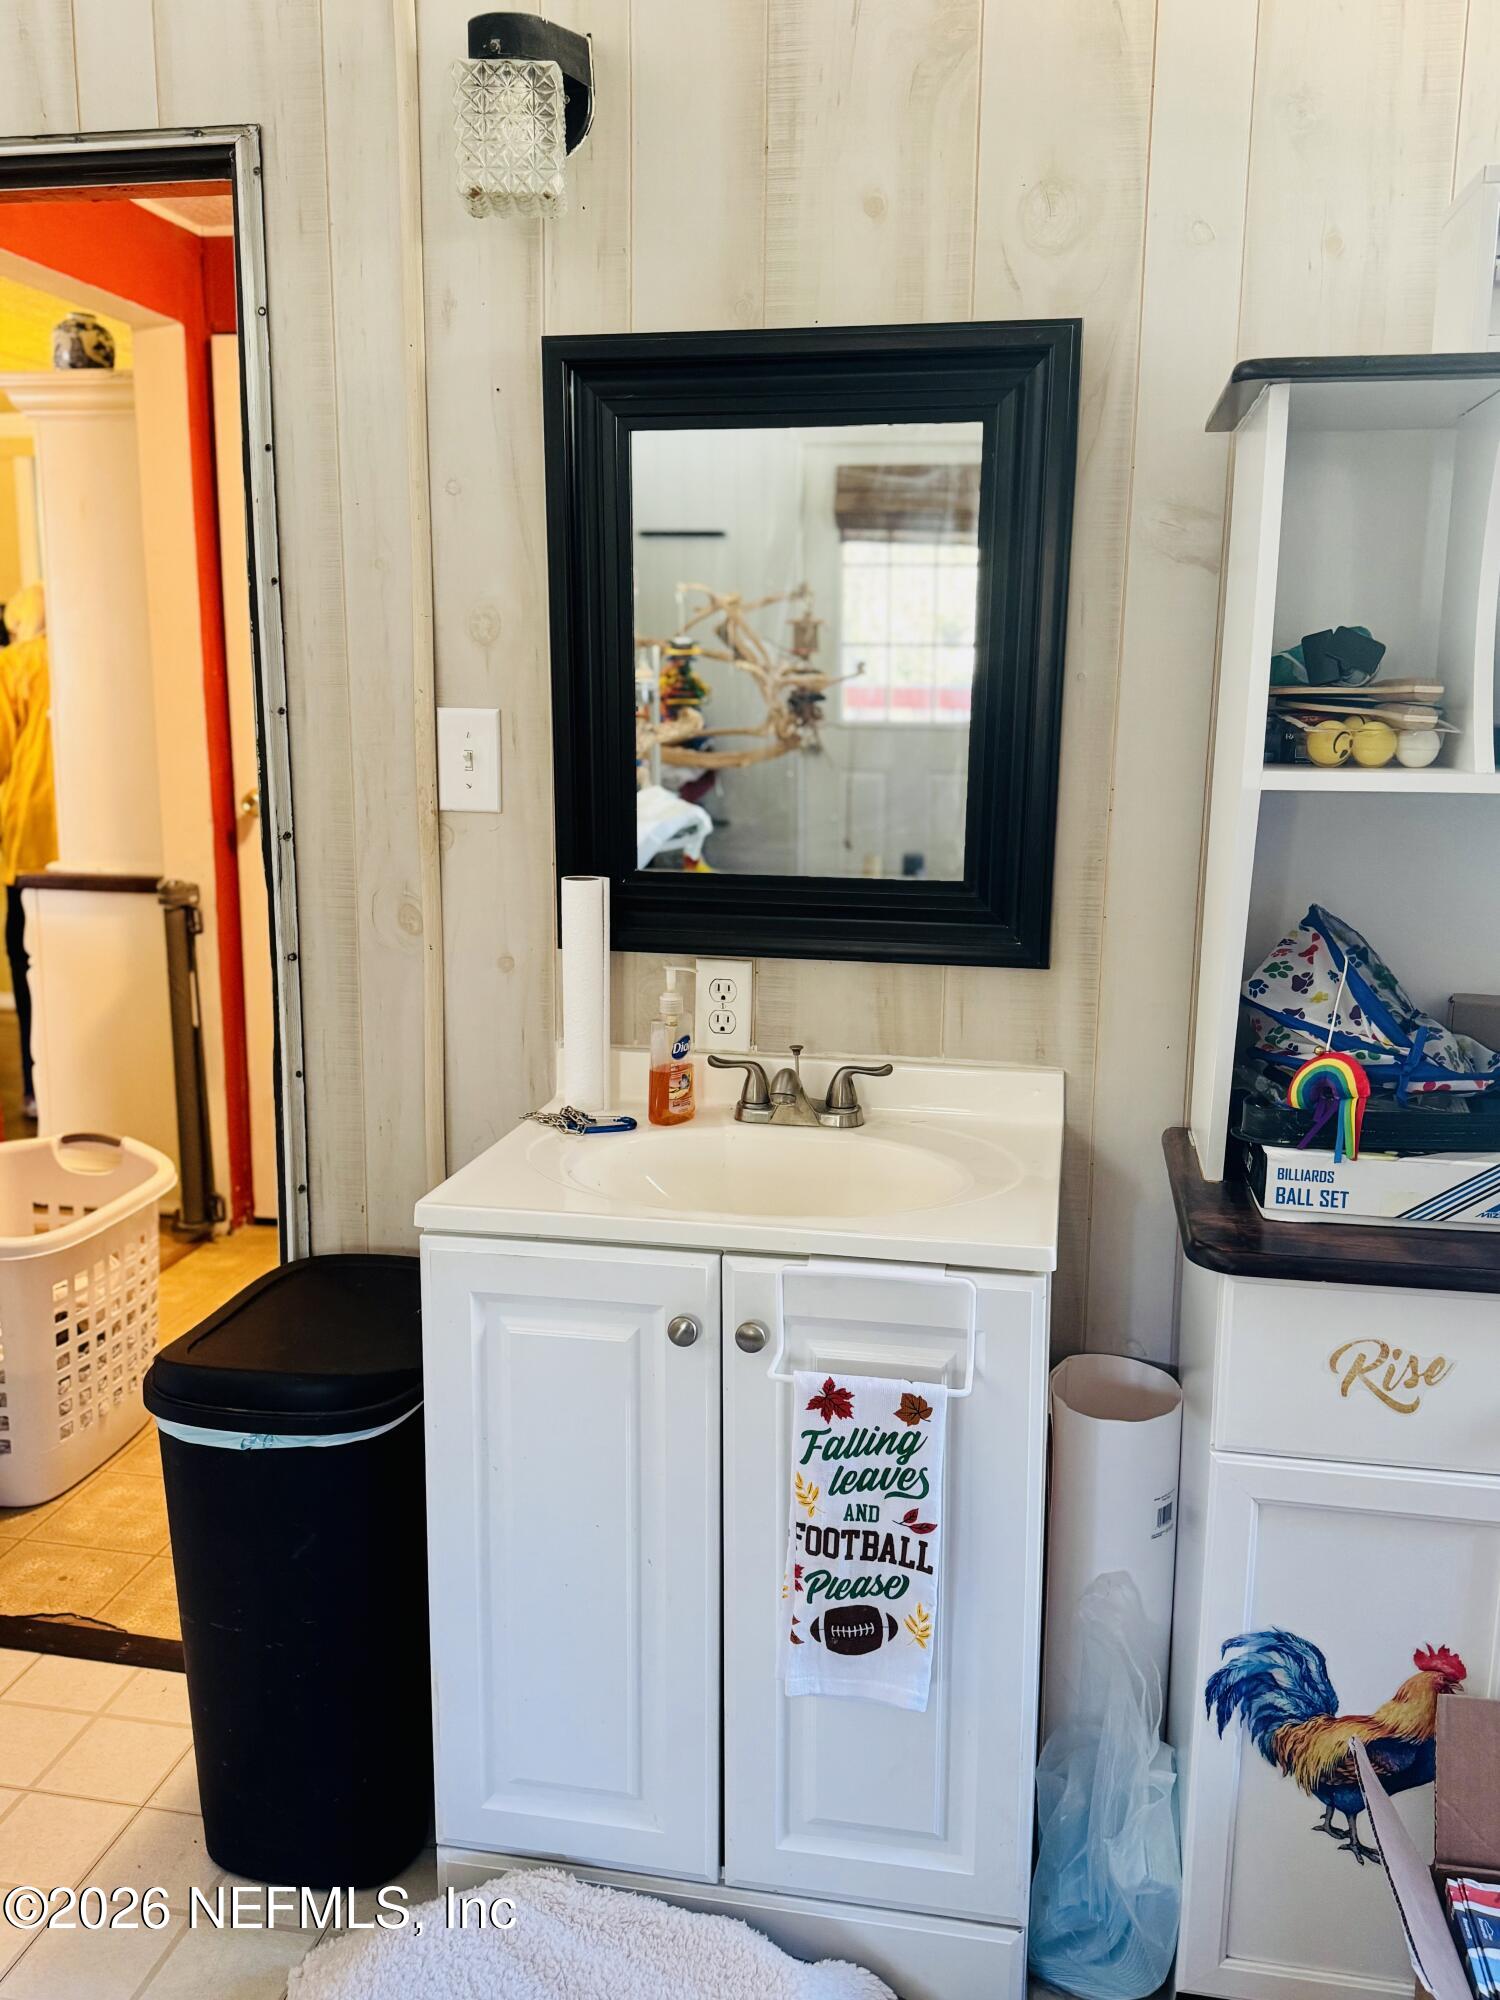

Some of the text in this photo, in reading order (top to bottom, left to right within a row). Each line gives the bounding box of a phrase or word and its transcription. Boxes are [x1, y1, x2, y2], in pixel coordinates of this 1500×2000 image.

[1277, 1167, 1335, 1184] BILLIARDS
[1275, 1186, 1349, 1209] BALL SET
[1329, 1339, 1455, 1414] Rise
[801, 1426, 928, 1465] Falling
[828, 1466, 930, 1500] leaves
[843, 1503, 880, 1523] AND
[804, 1569, 910, 1604] Please
